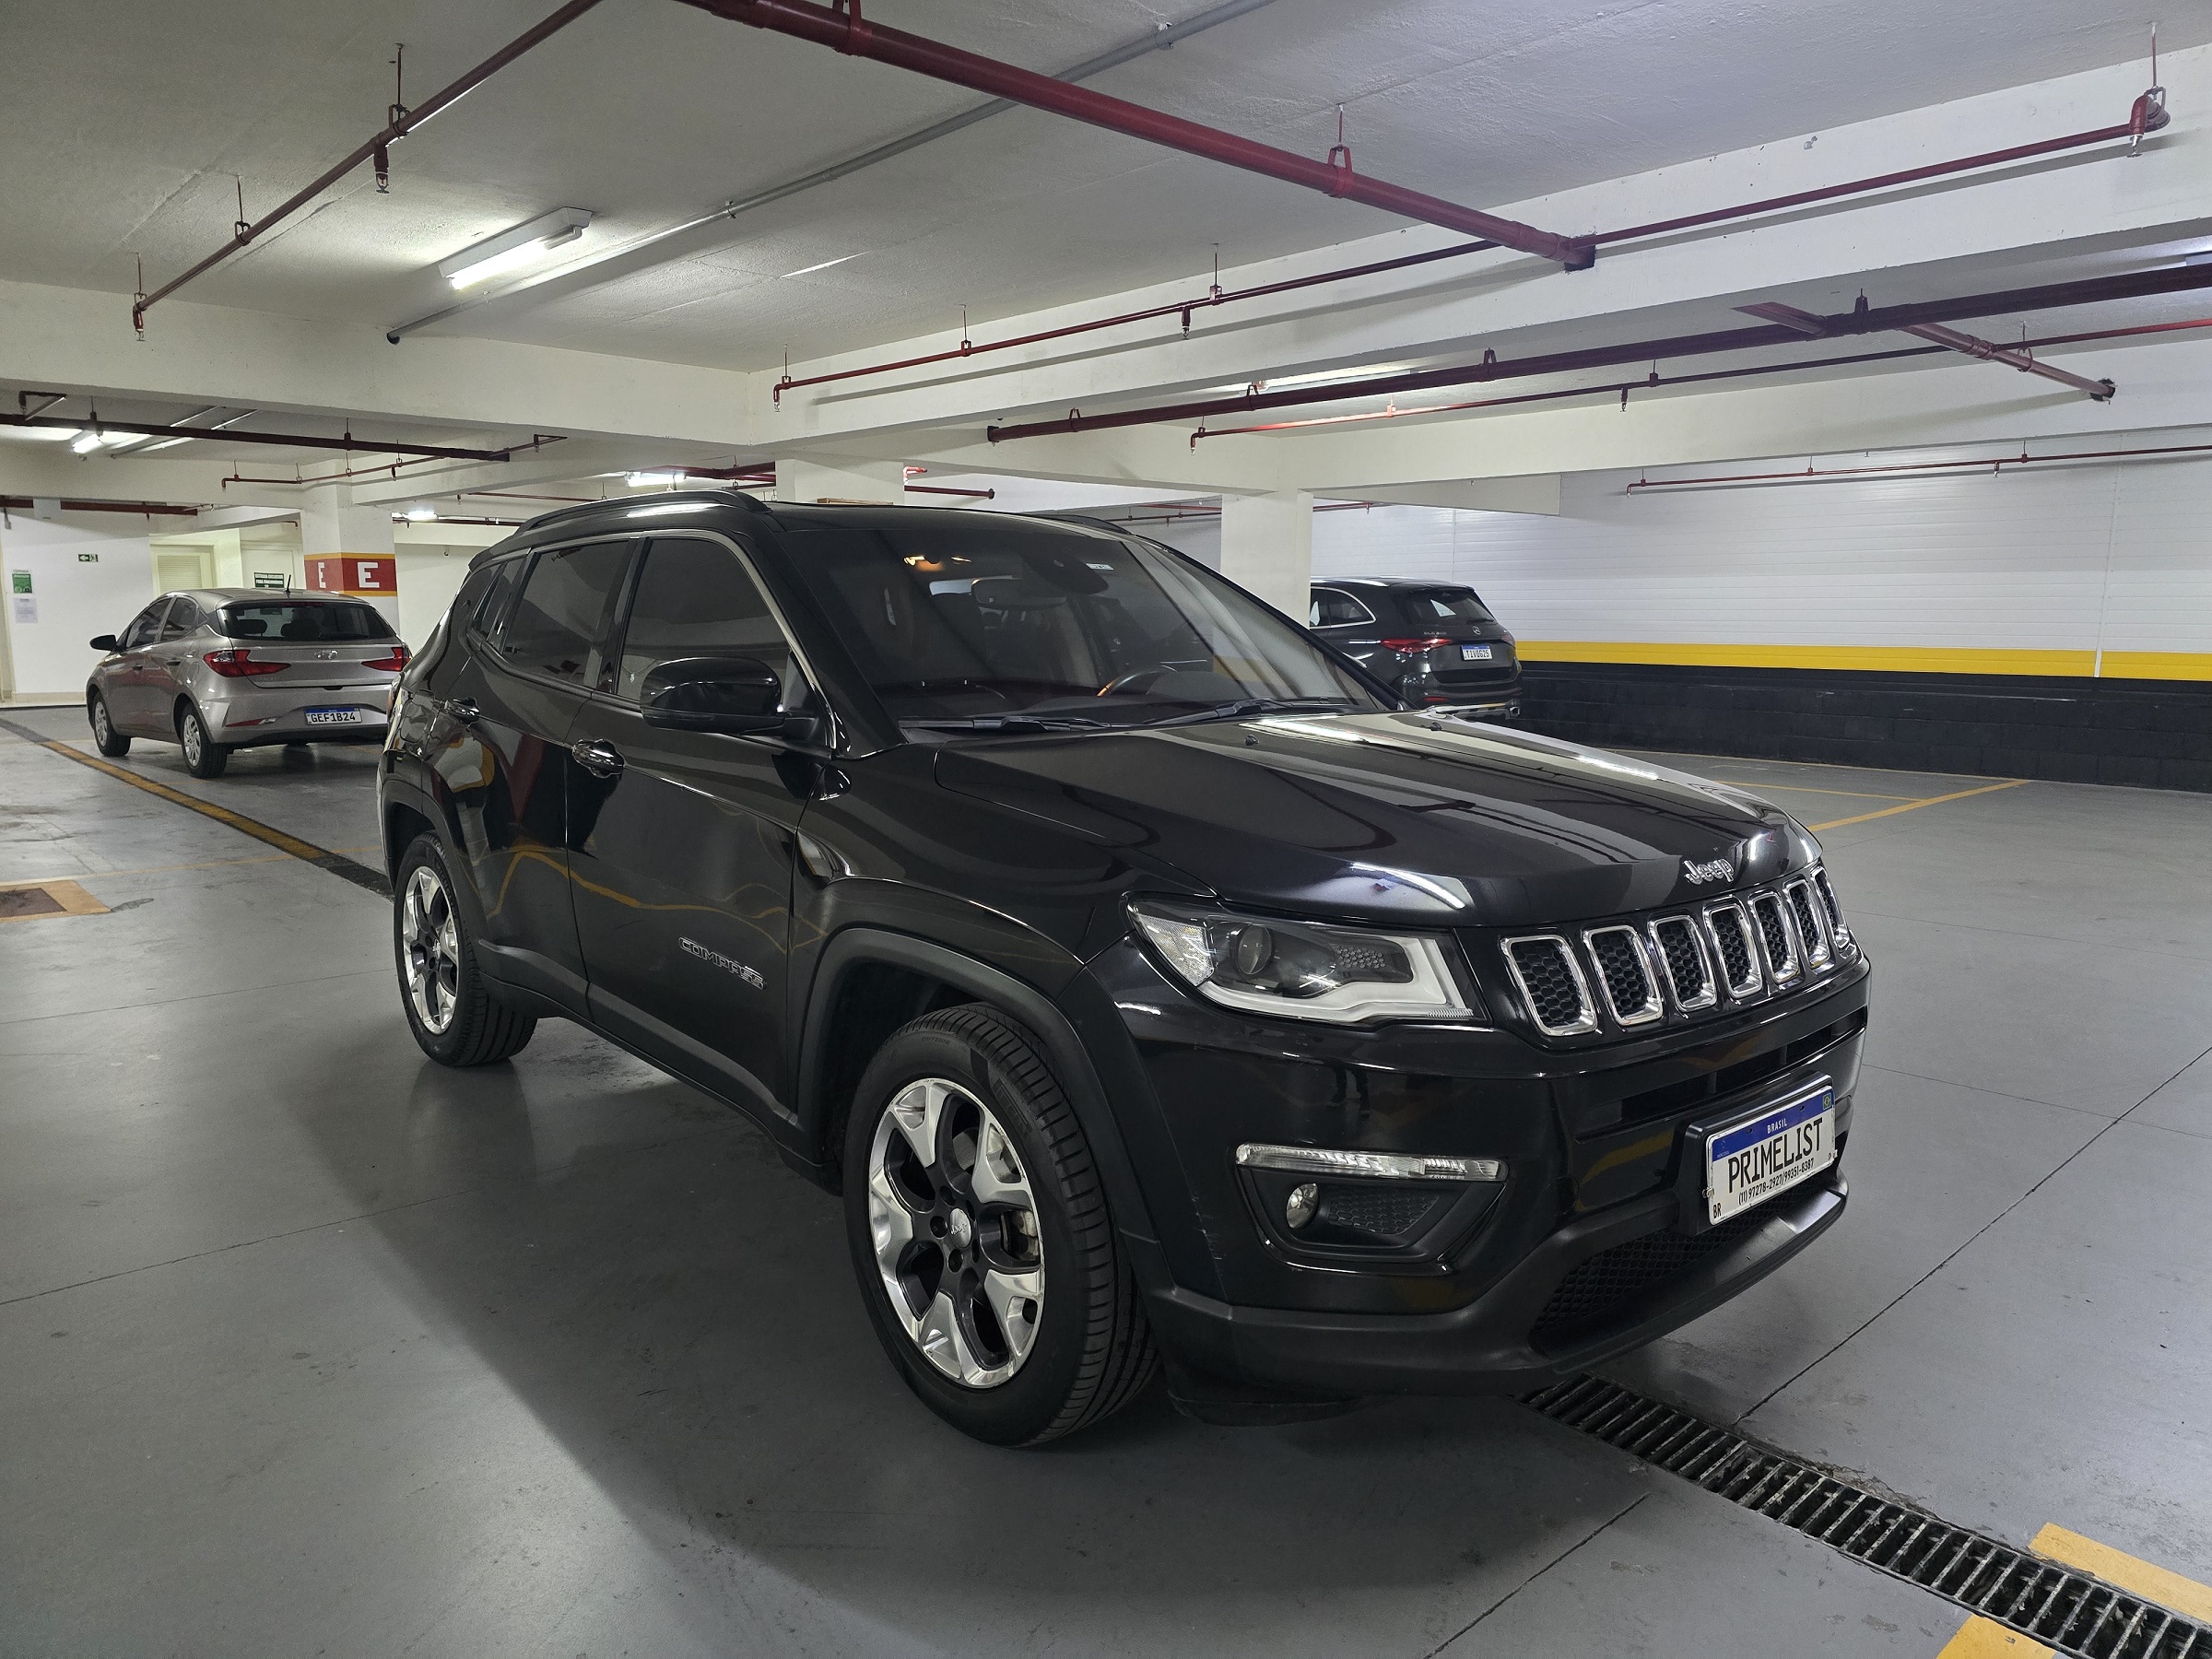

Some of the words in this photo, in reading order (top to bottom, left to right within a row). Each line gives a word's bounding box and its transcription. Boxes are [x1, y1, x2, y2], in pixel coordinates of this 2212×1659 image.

[317, 562, 326, 588] E
[358, 562, 380, 588] E
[311, 712, 356, 723] GEF1B24
[1683, 858, 1734, 885] Jeep
[678, 936, 763, 990] COMPASS
[1767, 1118, 1788, 1135] BRASIL
[1728, 1116, 1823, 1194] PRIMELIST
[1712, 1202, 1722, 1218] BR
